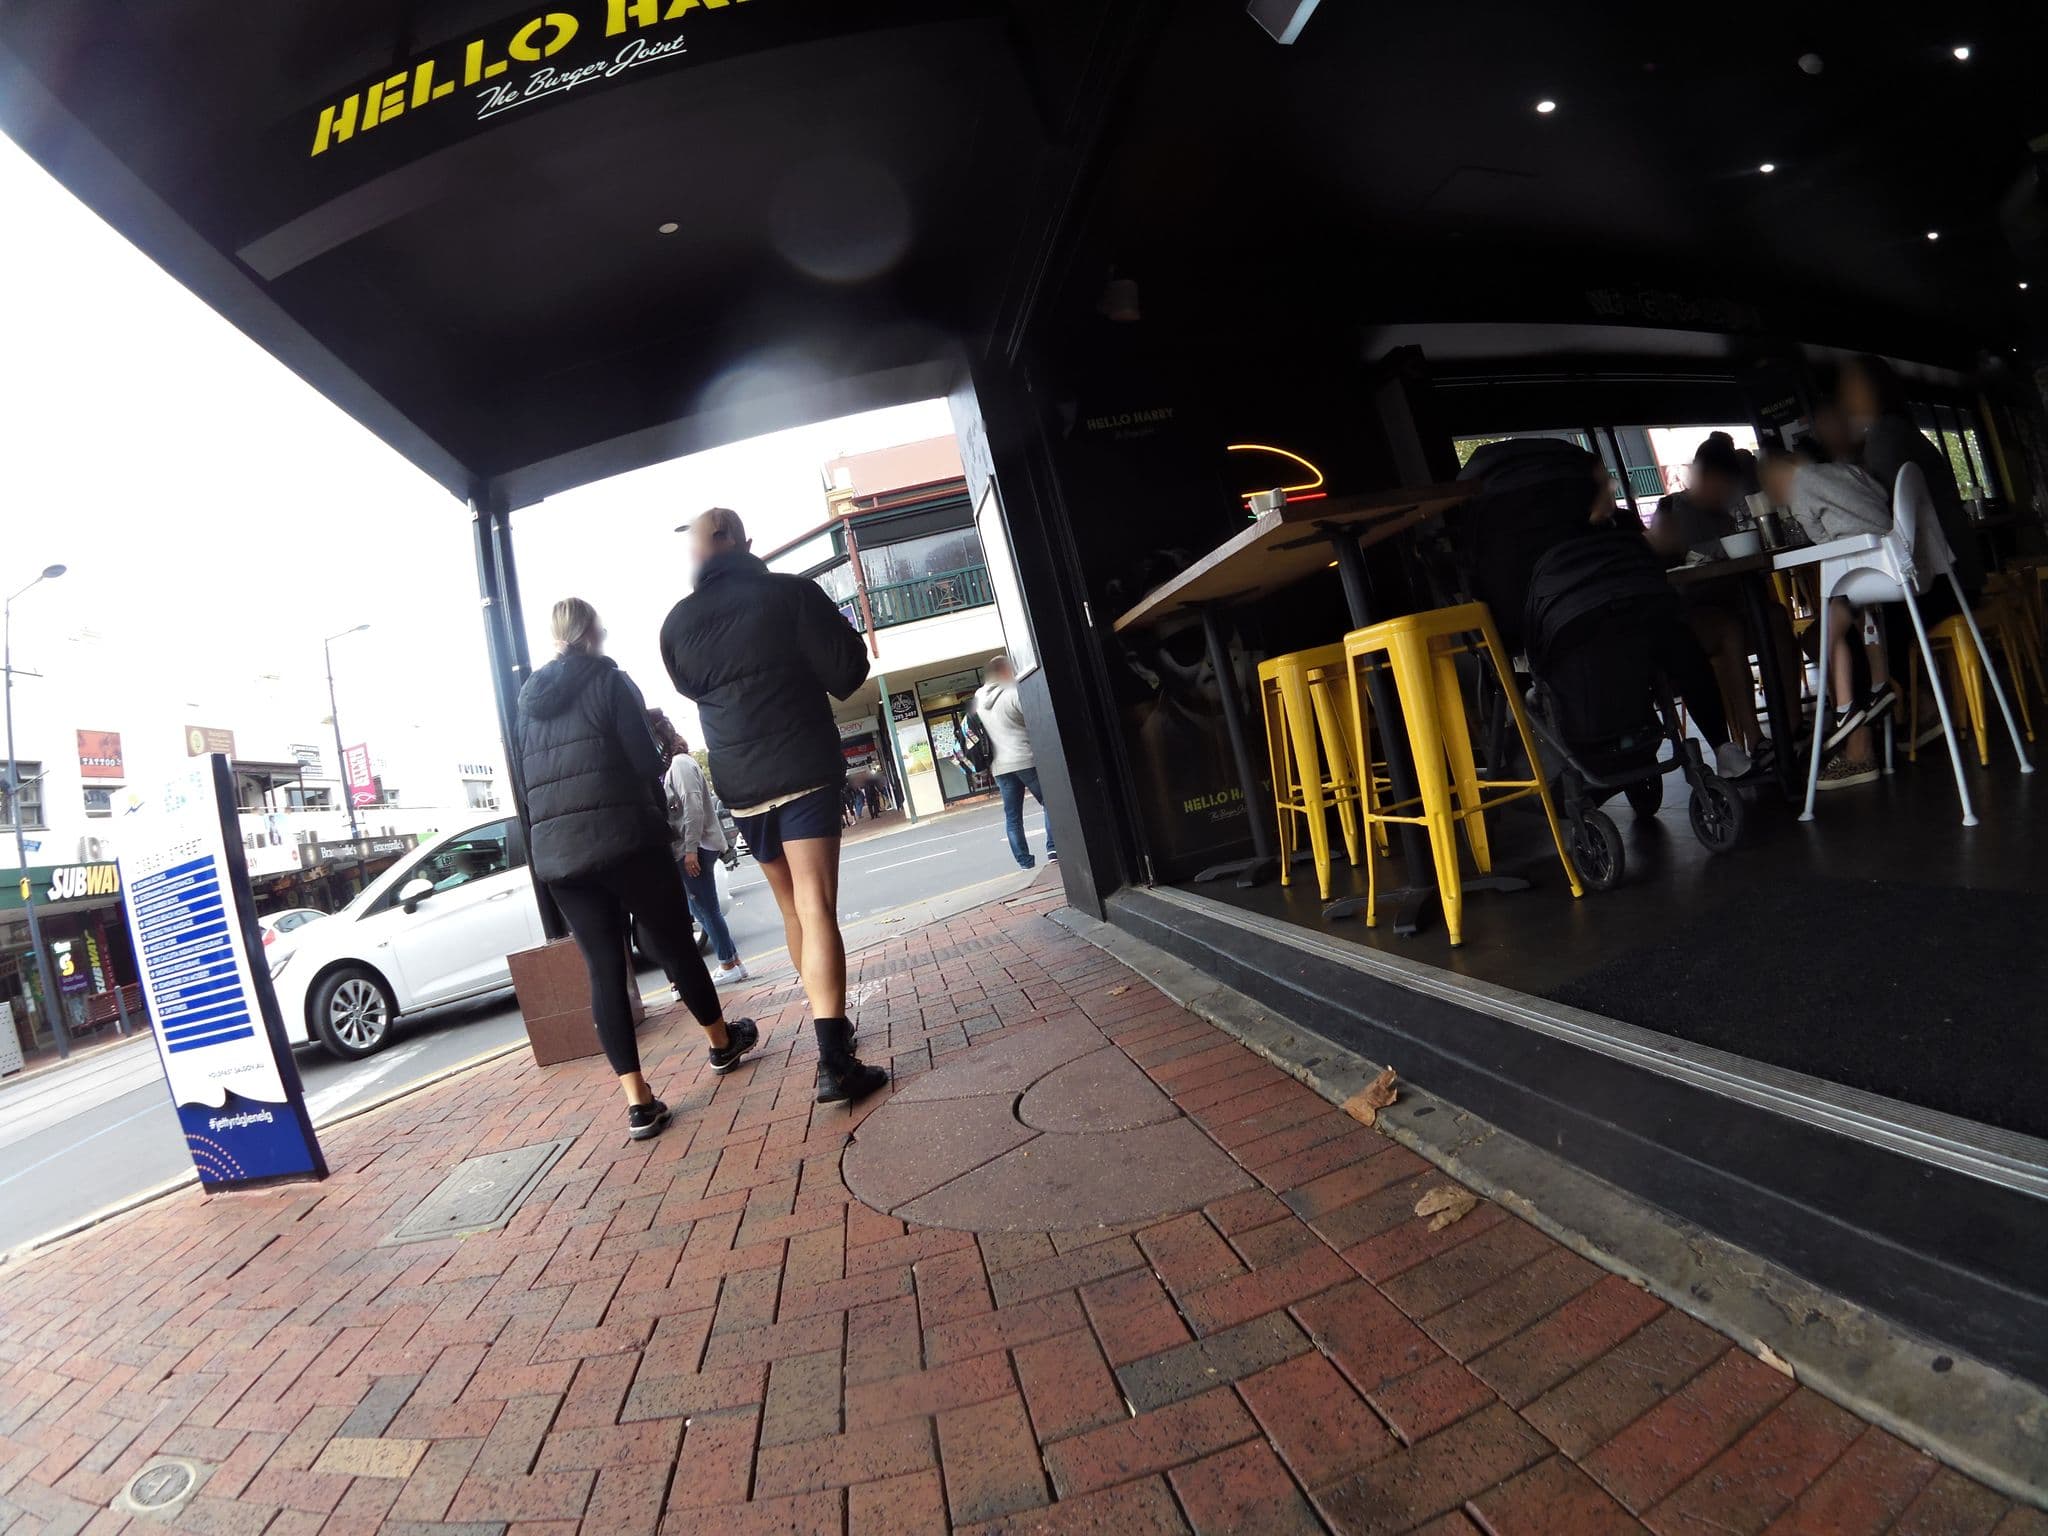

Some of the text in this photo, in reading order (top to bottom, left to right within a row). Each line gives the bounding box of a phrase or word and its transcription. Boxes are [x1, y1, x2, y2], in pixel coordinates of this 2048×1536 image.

[310, 12, 579, 157] HELLO
[476, 35, 685, 116] The Burger Joint
[1087, 413, 1131, 431] HELLO
[1183, 791, 1228, 813] HELLO
[84, 929, 107, 994] SUBWAY
